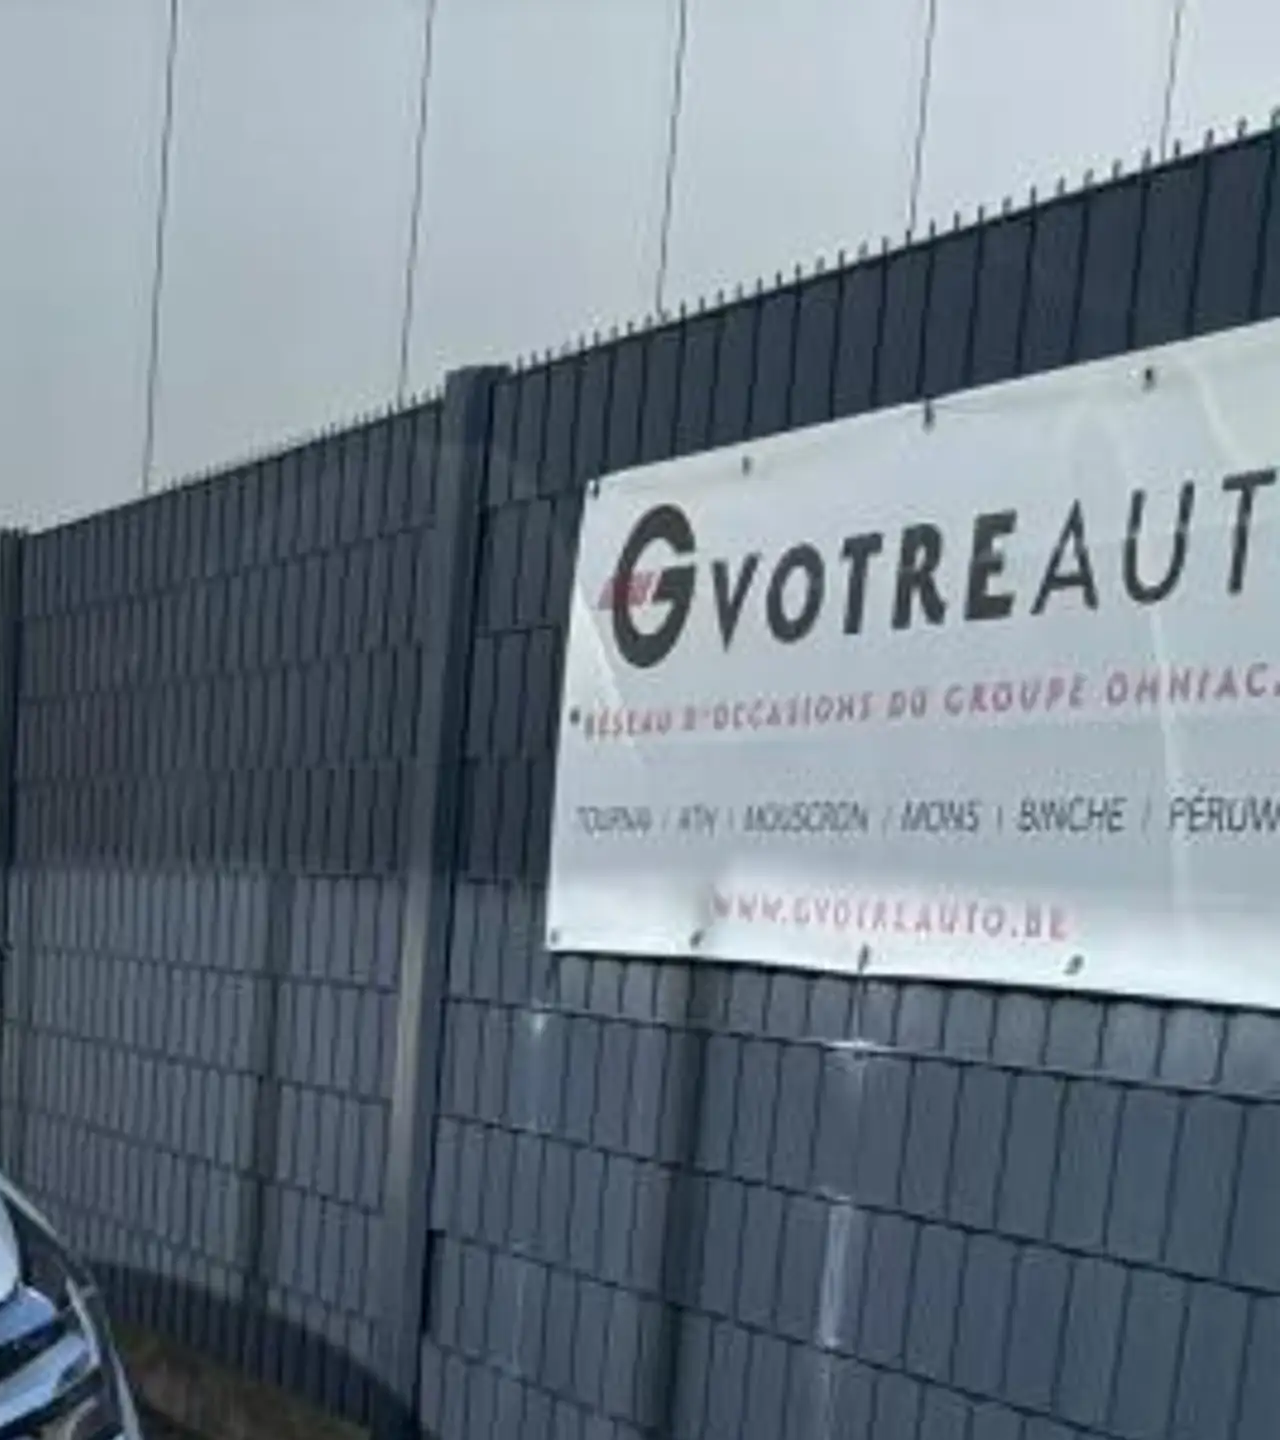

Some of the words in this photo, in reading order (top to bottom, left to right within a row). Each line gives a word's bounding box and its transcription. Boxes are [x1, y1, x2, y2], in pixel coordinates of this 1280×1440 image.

[943, 672, 1088, 717] GROUPE
[899, 799, 980, 832] MONS
[1016, 797, 1127, 833] BINCHE
